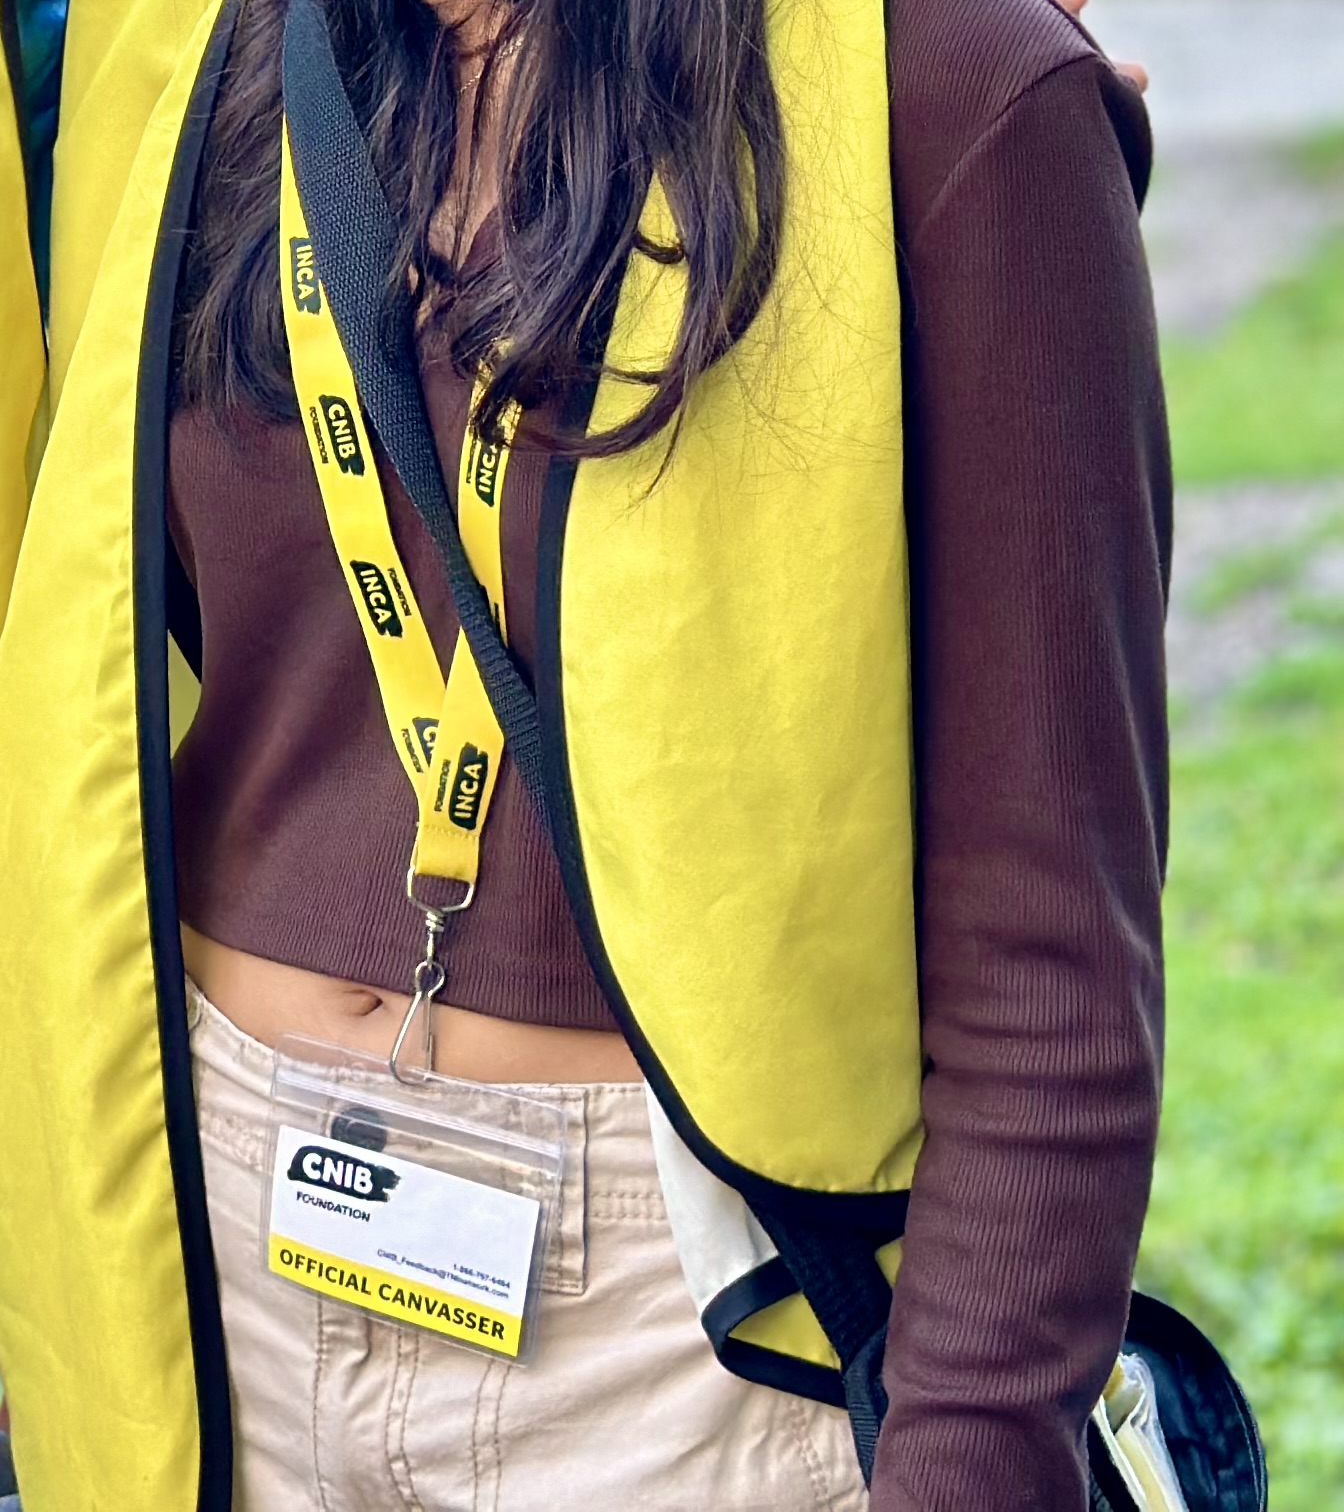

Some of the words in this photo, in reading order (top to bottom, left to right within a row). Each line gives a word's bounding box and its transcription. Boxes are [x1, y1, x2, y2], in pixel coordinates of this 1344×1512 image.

[295, 244, 315, 300] INCA
[328, 403, 356, 459] CNIB
[478, 445, 498, 494] INC
[361, 569, 392, 625] INCA
[454, 763, 483, 819] INCA
[302, 1152, 373, 1194] CNIB
[296, 1191, 371, 1222] FOUNDATION
[279, 1248, 371, 1296] OFFICIAL
[378, 1282, 506, 1340] CANVASSER
